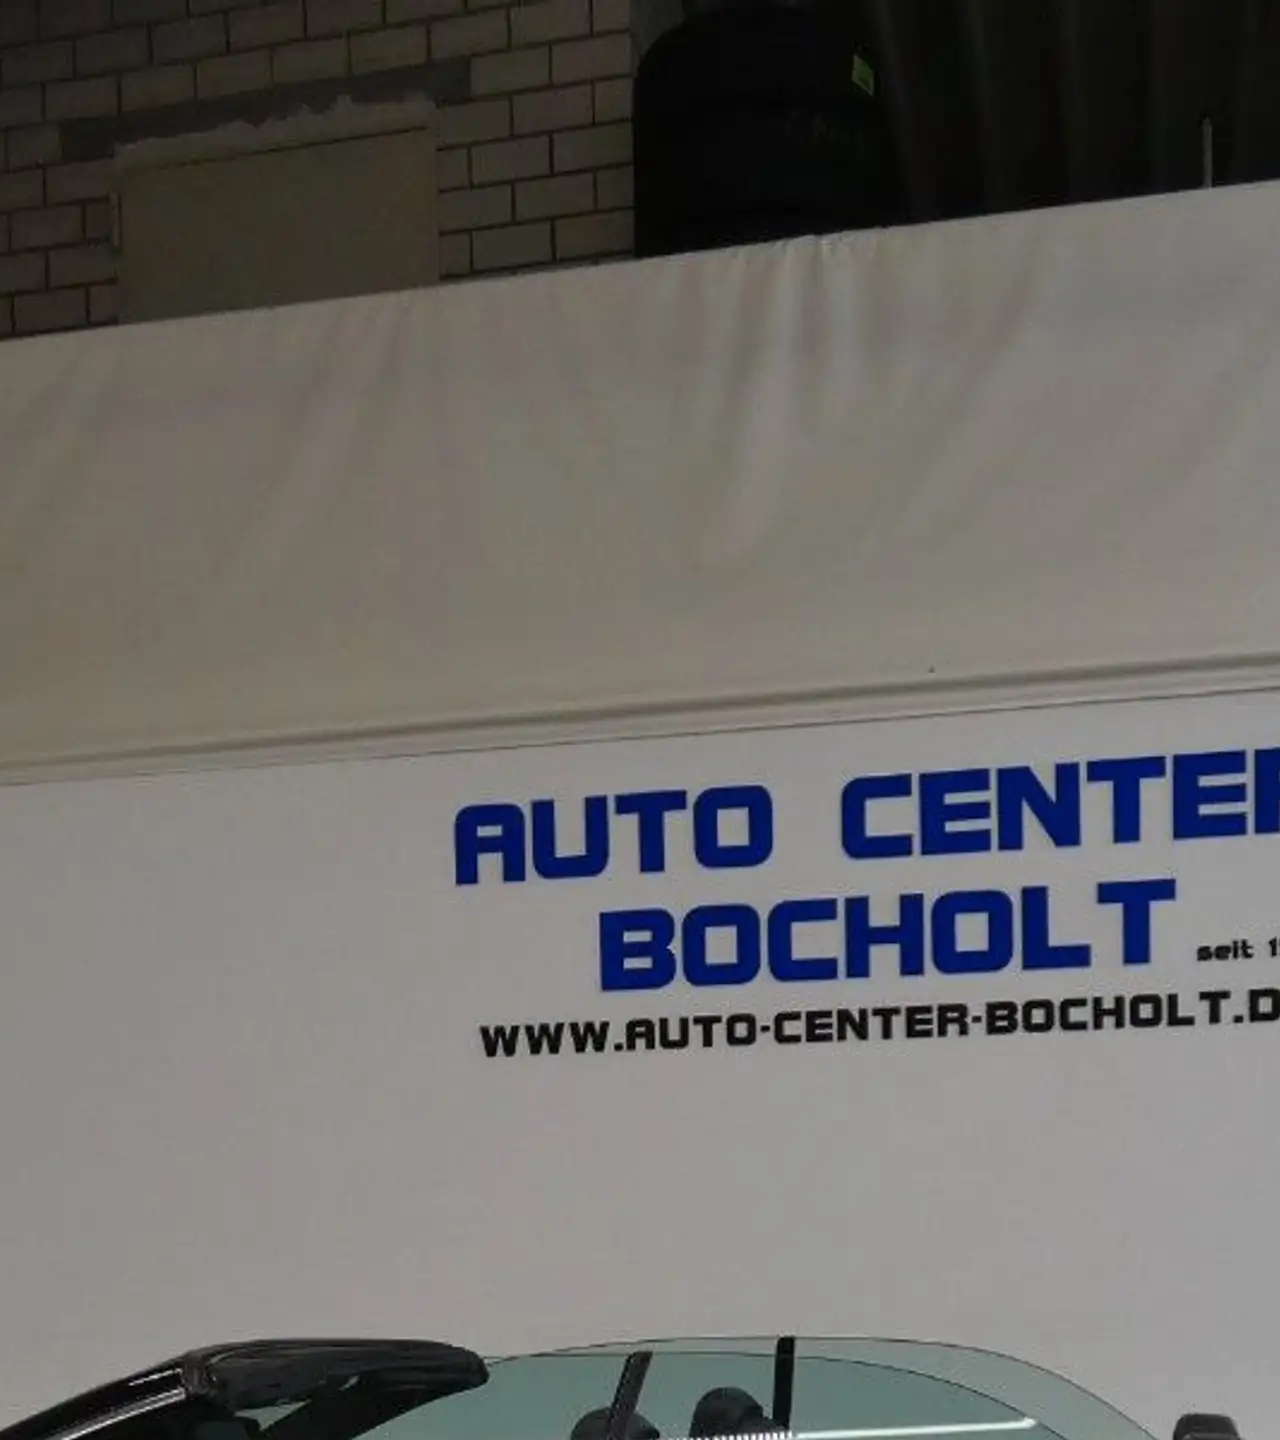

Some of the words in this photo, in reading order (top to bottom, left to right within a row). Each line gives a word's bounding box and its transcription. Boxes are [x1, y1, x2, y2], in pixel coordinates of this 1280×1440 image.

[454, 785, 774, 885] AUTO
[599, 879, 1176, 992] BOCHOLT
[1196, 937, 1254, 962] seit
